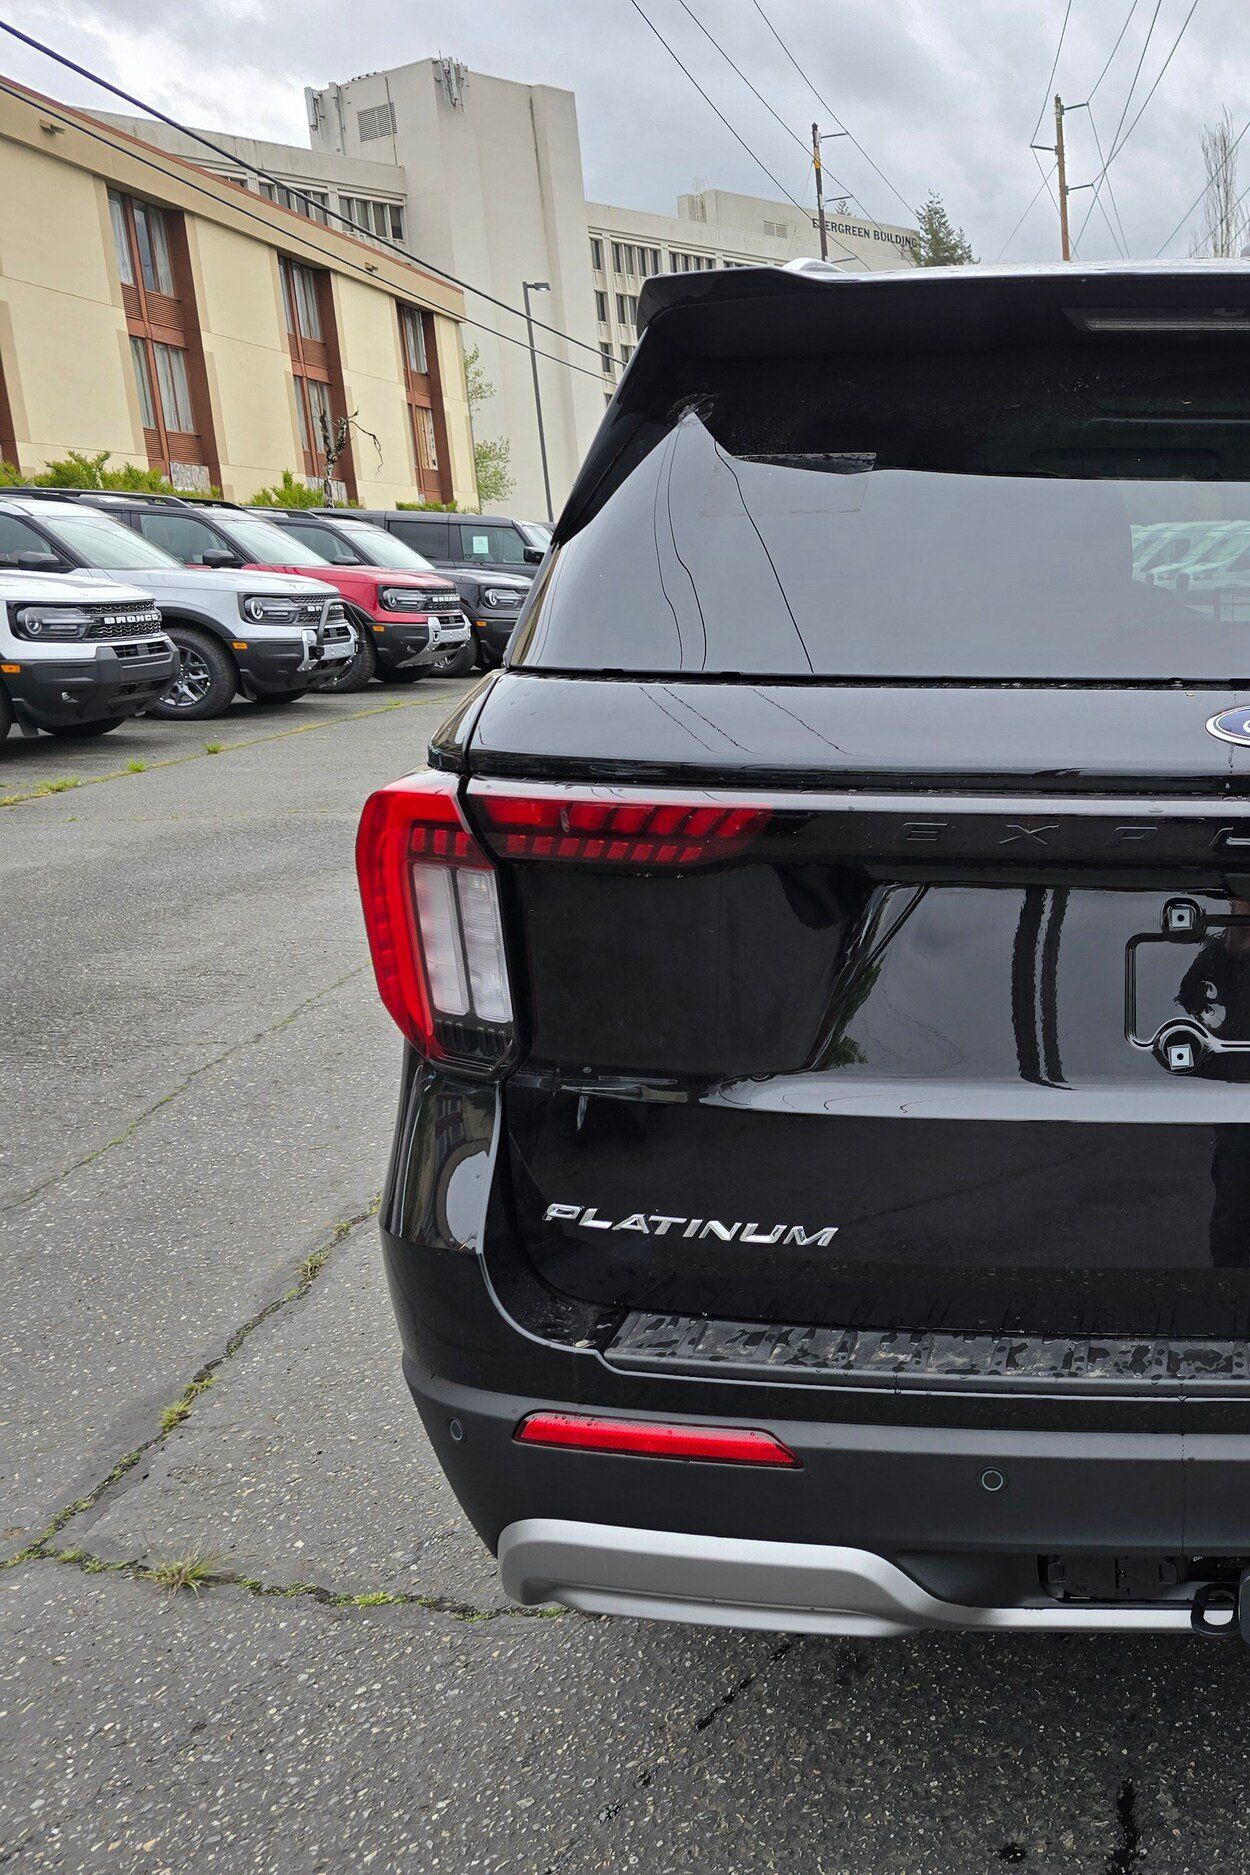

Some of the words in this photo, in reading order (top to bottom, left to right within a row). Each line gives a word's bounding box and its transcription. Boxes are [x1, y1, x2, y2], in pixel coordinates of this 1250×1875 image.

[812, 218, 870, 239] EERGREEN
[873, 230, 918, 248] BUILDING
[104, 613, 159, 625] BRONCO
[542, 1203, 839, 1247] PLATINUM
